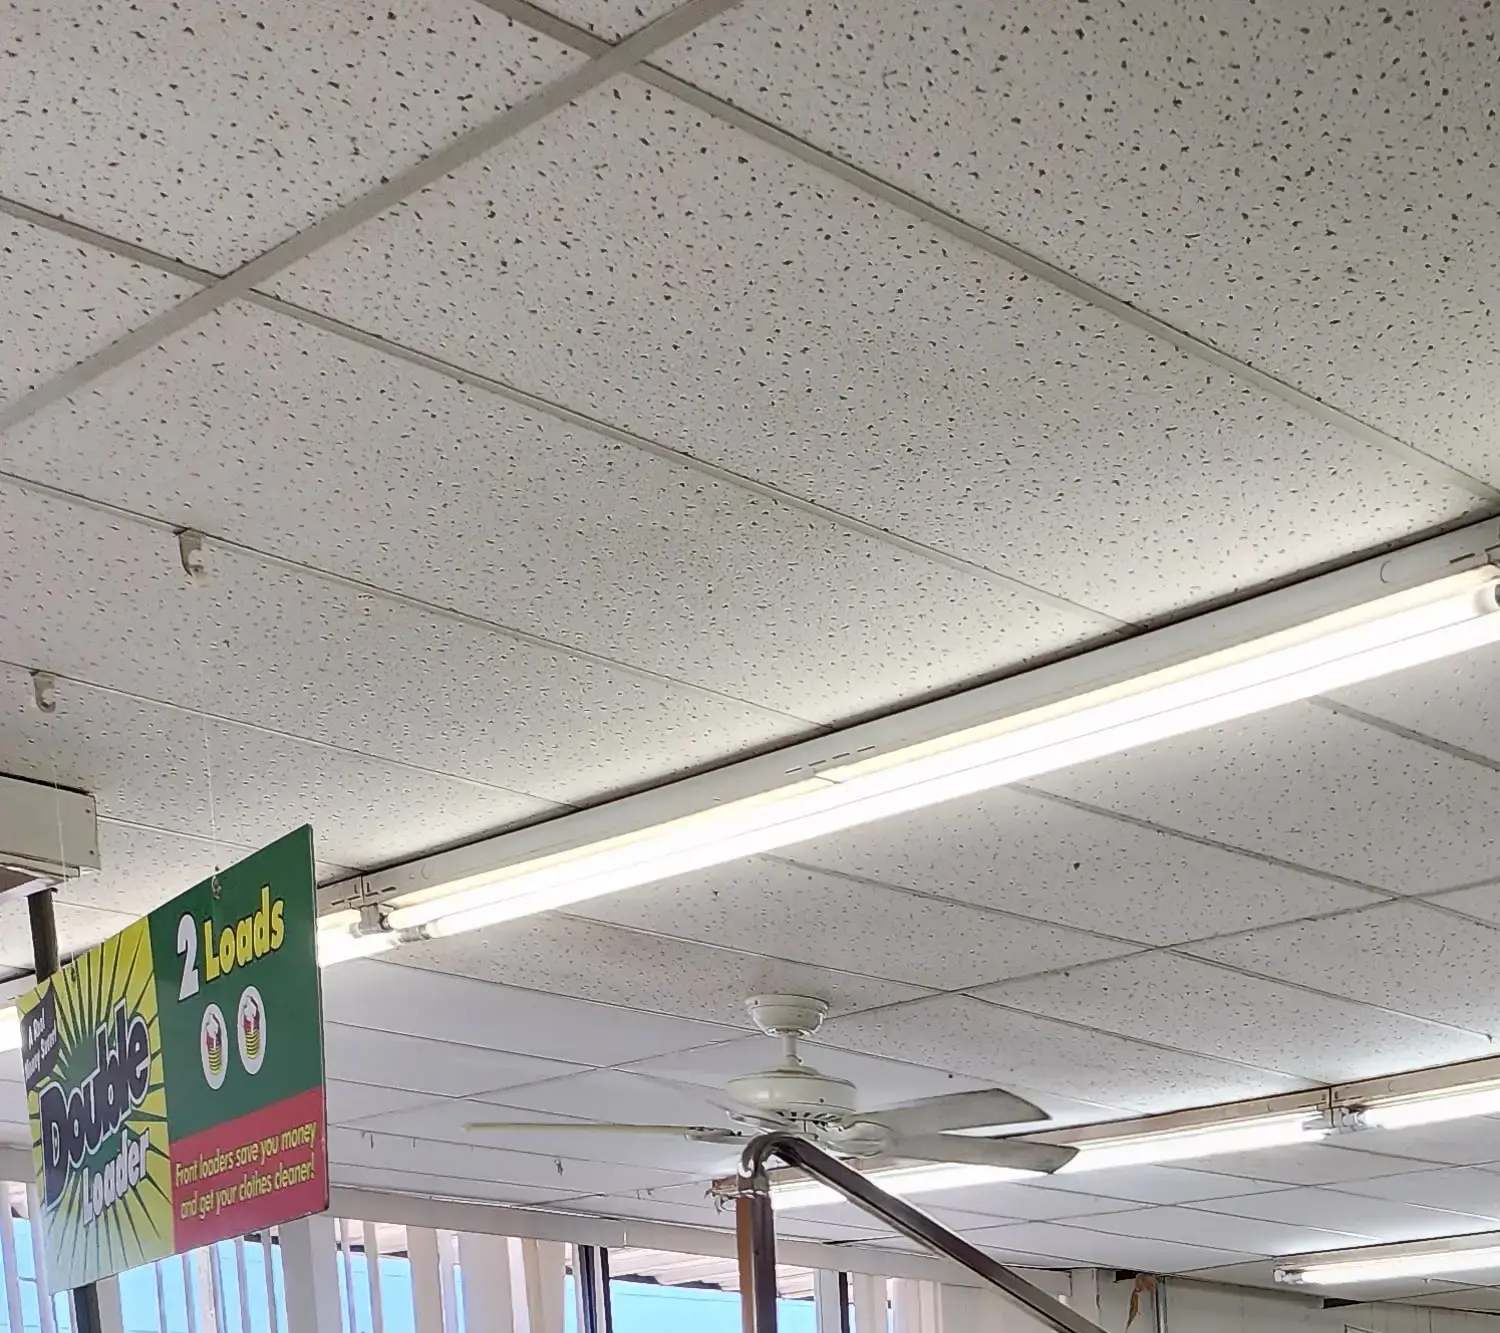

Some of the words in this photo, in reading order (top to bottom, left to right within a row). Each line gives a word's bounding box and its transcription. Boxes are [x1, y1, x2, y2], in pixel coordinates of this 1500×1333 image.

[178, 913, 199, 1001] 2
[203, 885, 284, 983] Loads
[38, 998, 152, 1211] Double
[175, 1160, 197, 1187] Front
[199, 1148, 234, 1179] loaders
[236, 1142, 258, 1167] save
[260, 1135, 279, 1165] you
[280, 1121, 317, 1150] money
[82, 1127, 150, 1226] Loader
[180, 1190, 198, 1220] and
[199, 1189, 214, 1220] get
[215, 1185, 238, 1215] your
[239, 1171, 272, 1201] clothes
[274, 1152, 316, 1190] cleaner!
